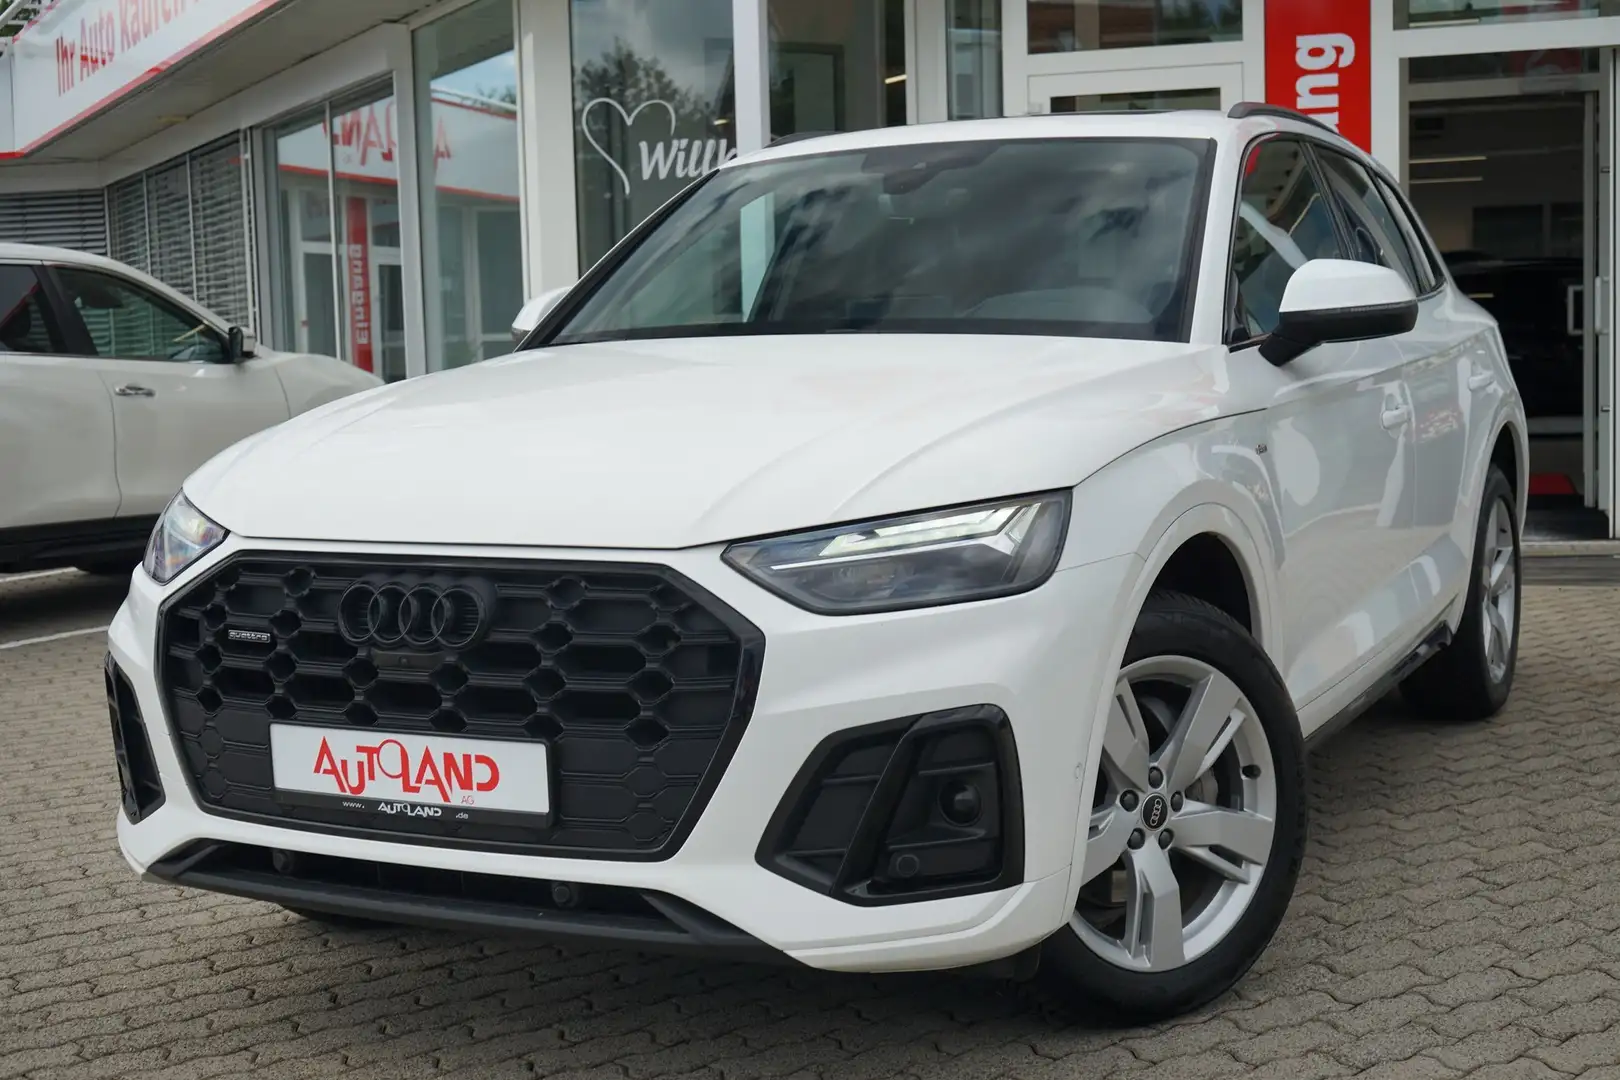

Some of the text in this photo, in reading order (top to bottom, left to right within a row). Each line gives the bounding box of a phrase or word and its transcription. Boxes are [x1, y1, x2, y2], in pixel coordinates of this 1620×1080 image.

[56, 31, 76, 97] Ihr
[79, 8, 115, 82] Auto
[342, 801, 365, 809] www.
[461, 795, 475, 805] AG
